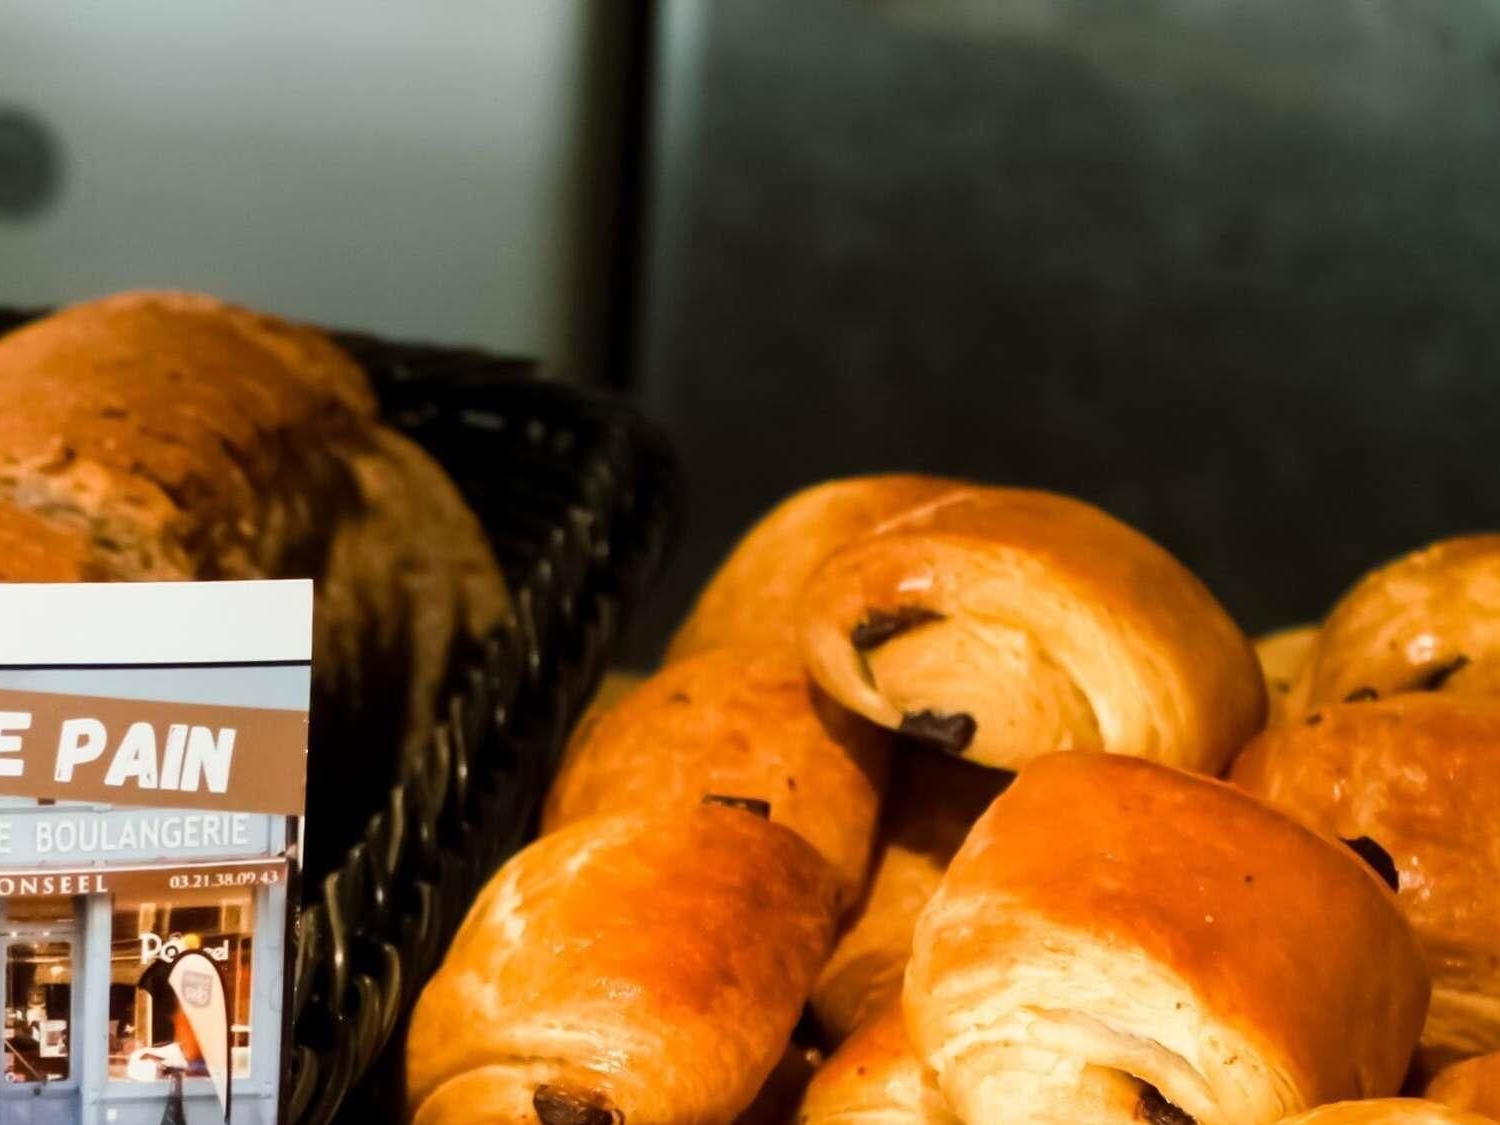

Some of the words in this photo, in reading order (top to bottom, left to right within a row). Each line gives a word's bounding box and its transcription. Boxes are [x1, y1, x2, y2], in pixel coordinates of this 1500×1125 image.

[54, 717, 237, 794] PAIN
[36, 814, 249, 852] BOULANGERIE
[169, 870, 279, 889] 03.21.38.09.43
